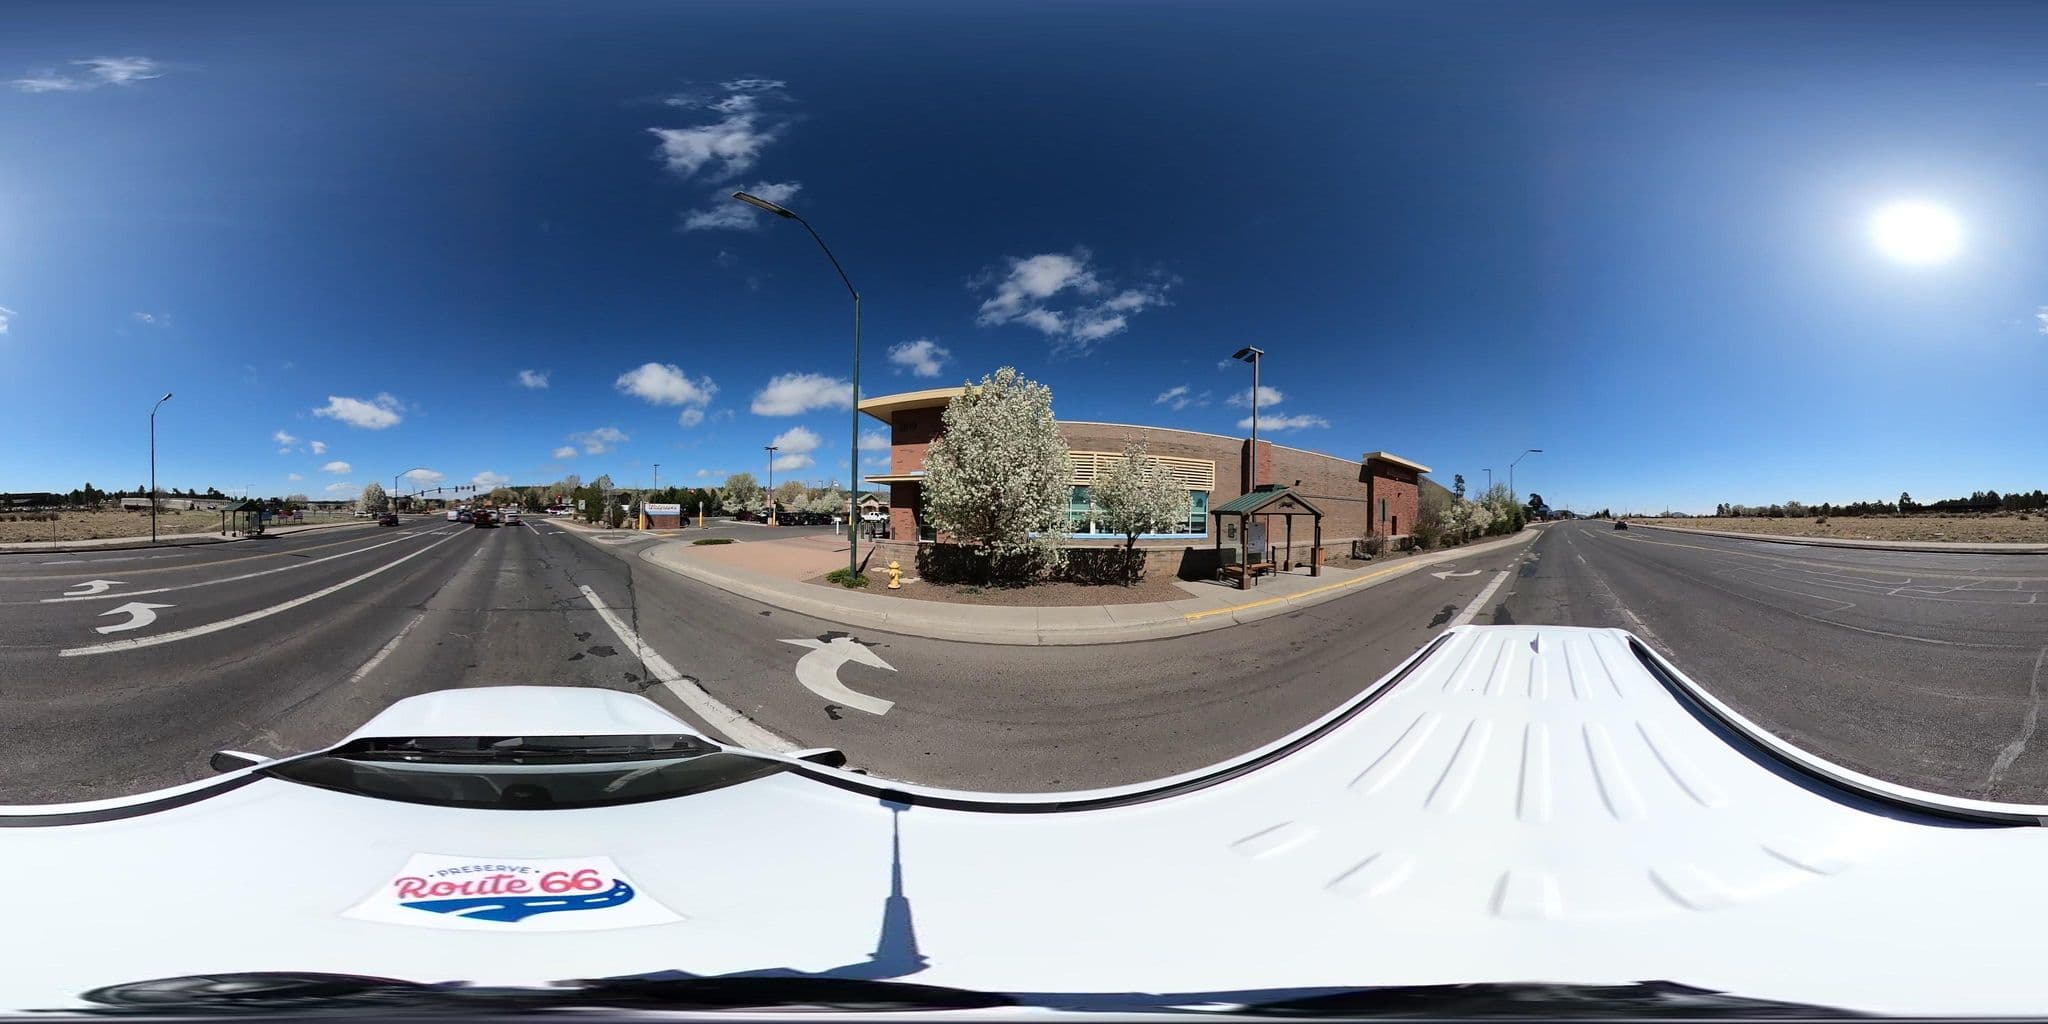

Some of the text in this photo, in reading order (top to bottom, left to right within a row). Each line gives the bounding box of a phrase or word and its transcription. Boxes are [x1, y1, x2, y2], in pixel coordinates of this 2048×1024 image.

[438, 864, 530, 876] PRESERVE
[394, 869, 604, 899] Route 66
